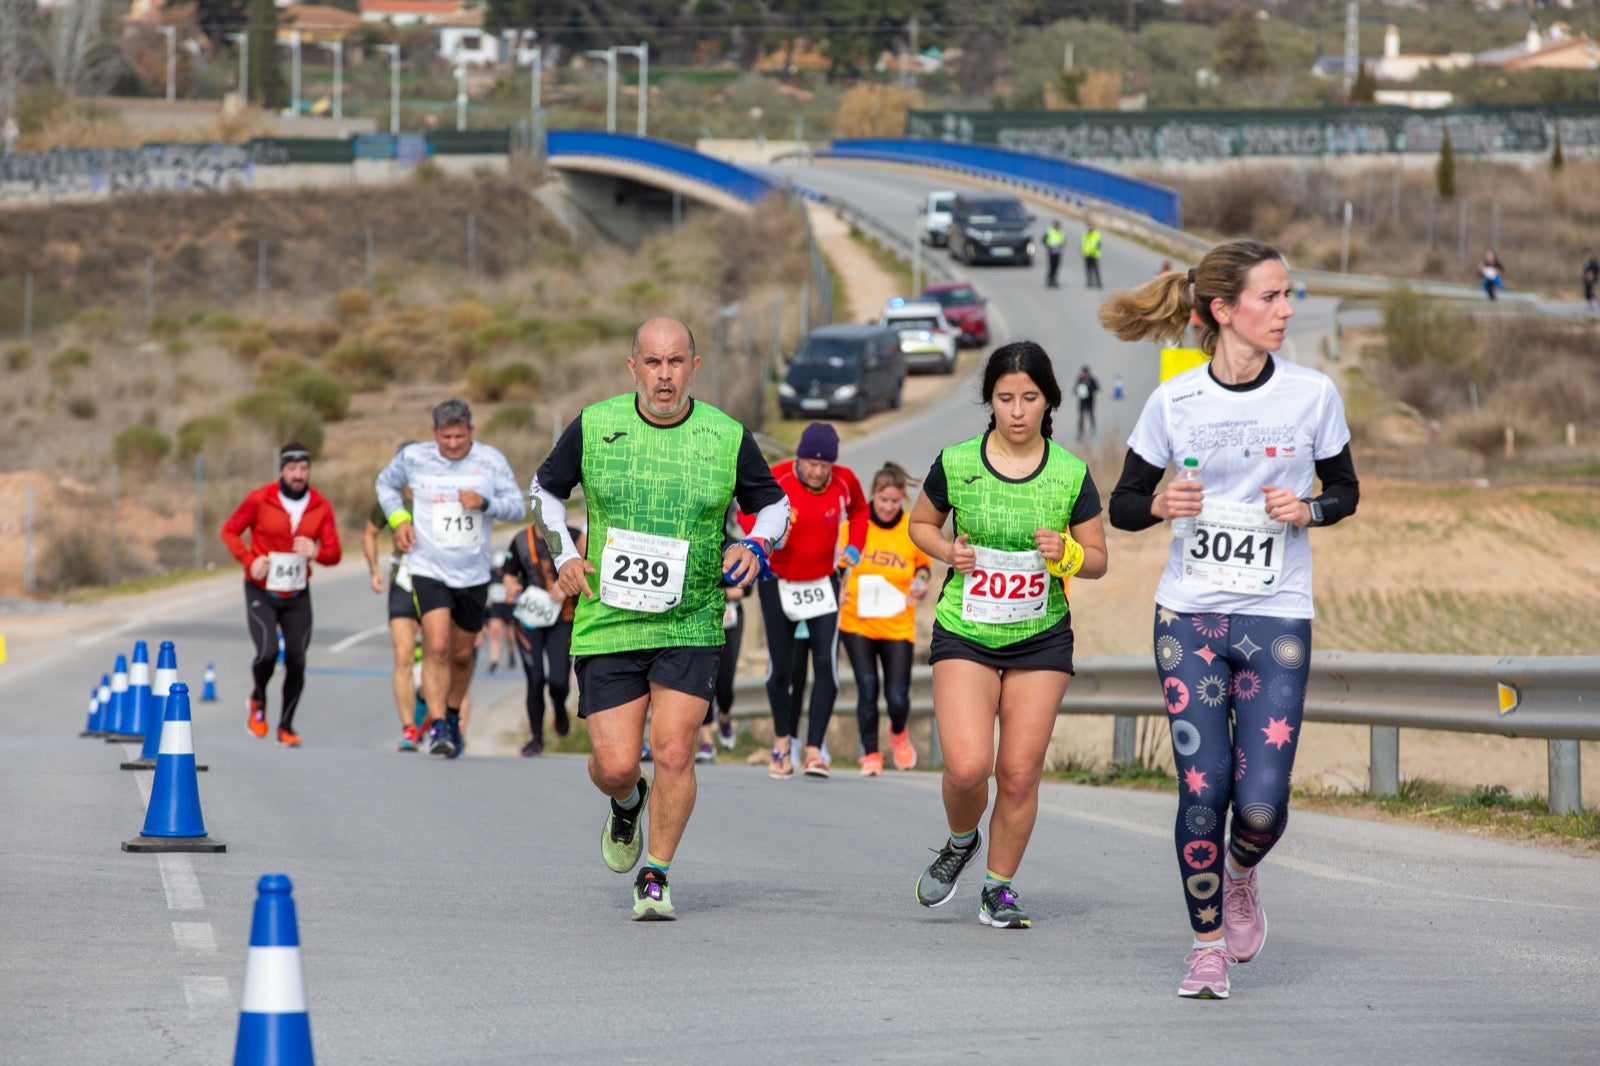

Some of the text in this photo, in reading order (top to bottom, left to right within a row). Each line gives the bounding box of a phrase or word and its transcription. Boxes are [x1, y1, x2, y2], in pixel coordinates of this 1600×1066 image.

[443, 515, 474, 532] 713
[1189, 528, 1275, 568] 3041
[612, 554, 670, 588] 239
[969, 568, 1046, 600] 2025
[792, 588, 826, 606] 359
